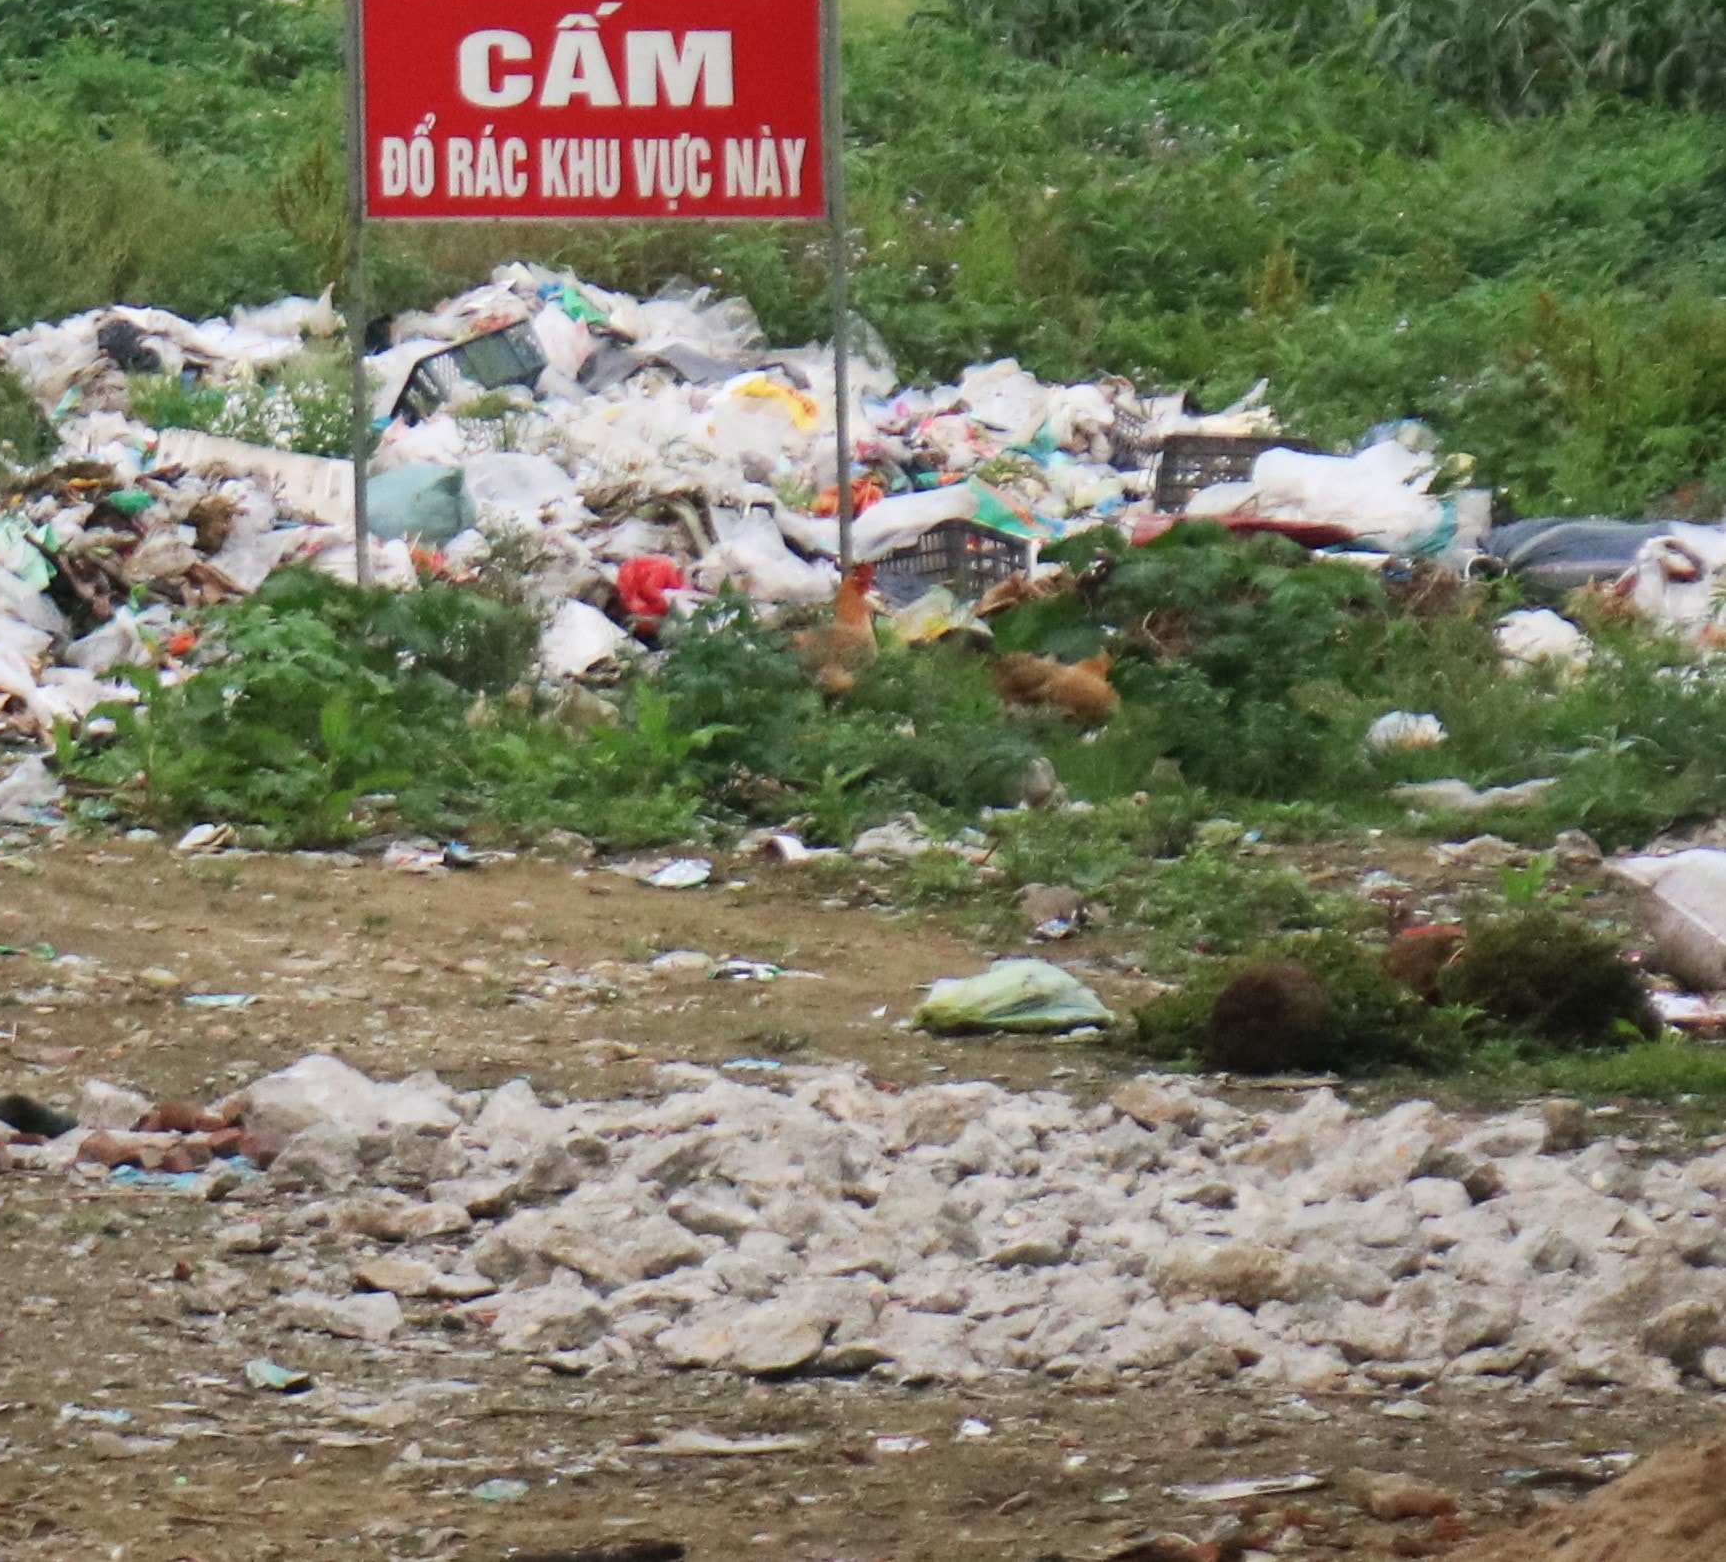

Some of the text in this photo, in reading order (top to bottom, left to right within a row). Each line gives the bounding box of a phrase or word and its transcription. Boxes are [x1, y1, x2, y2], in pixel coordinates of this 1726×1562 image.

[457, 1, 735, 109] CẤM
[379, 112, 806, 211] ĐỔ RÁC KHU VỰC NÀY
